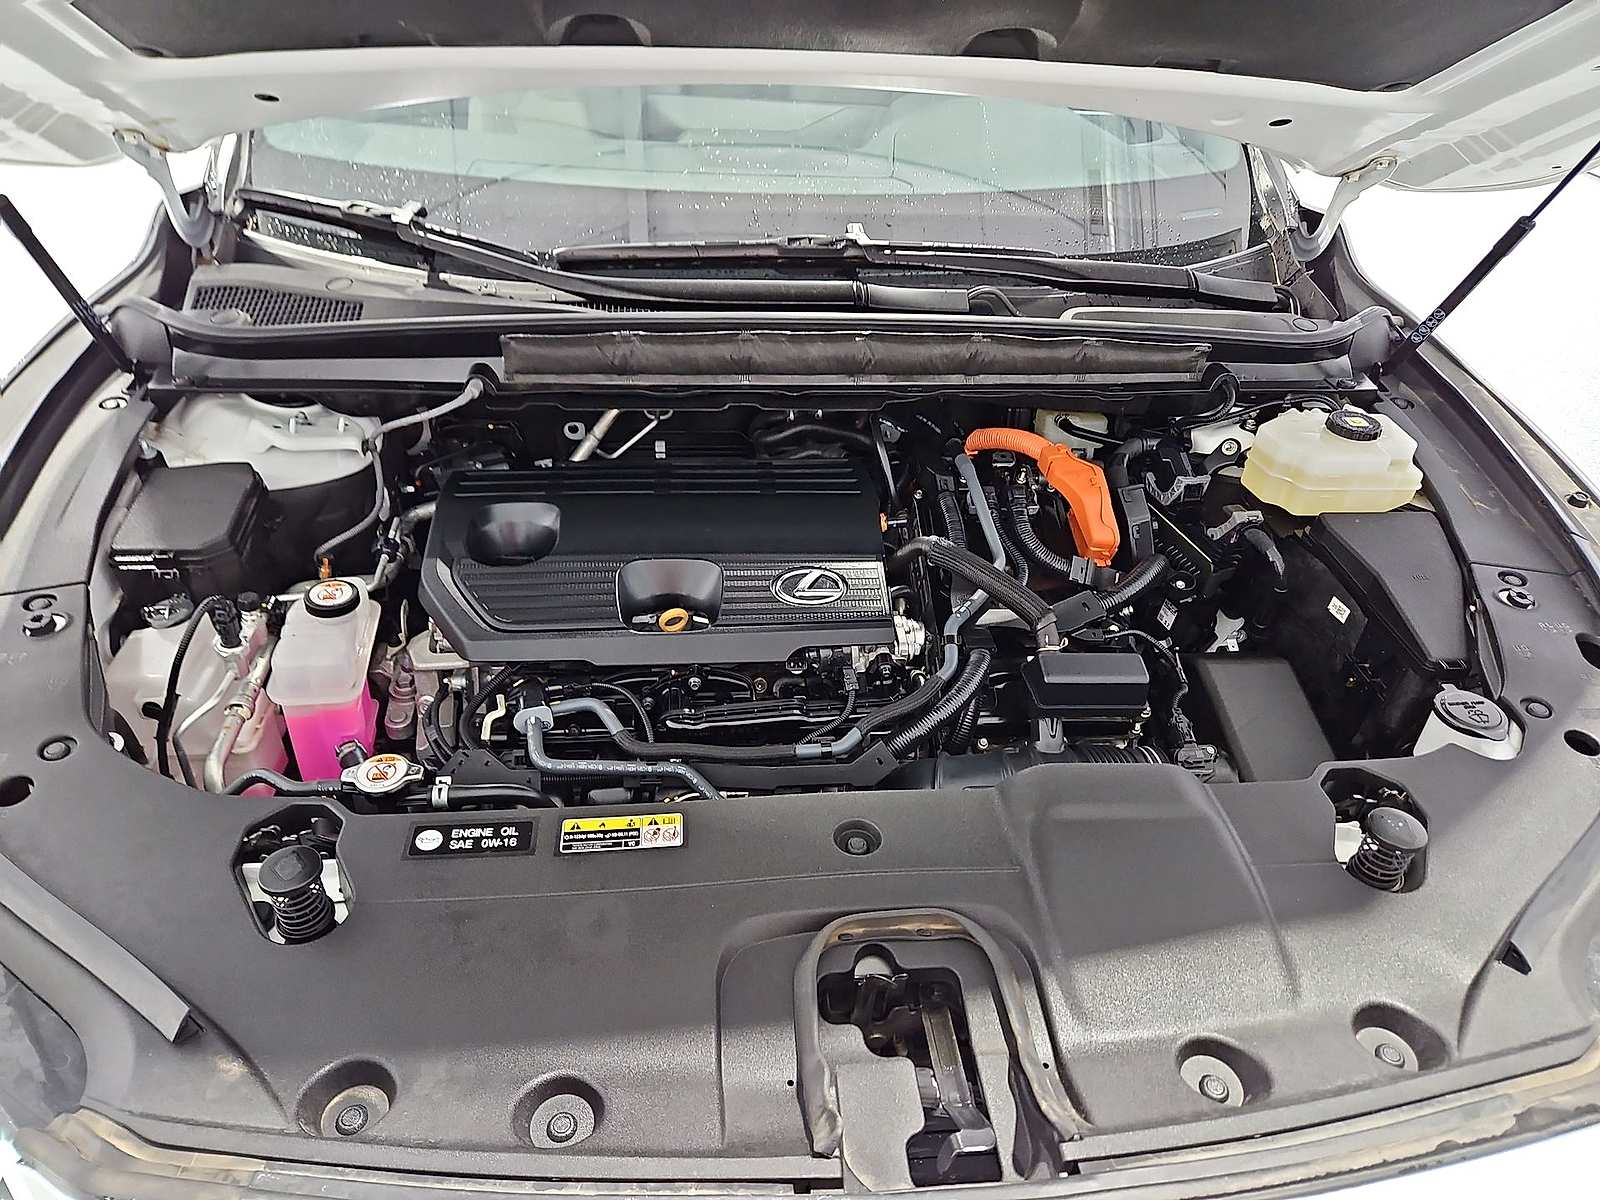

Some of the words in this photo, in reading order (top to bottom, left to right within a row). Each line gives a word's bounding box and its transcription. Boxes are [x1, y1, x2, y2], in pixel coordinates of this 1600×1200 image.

[451, 827, 494, 838] ENGINE
[500, 826, 519, 836] OIL
[449, 839, 474, 849] SAE
[481, 837, 518, 848] 0W-16
